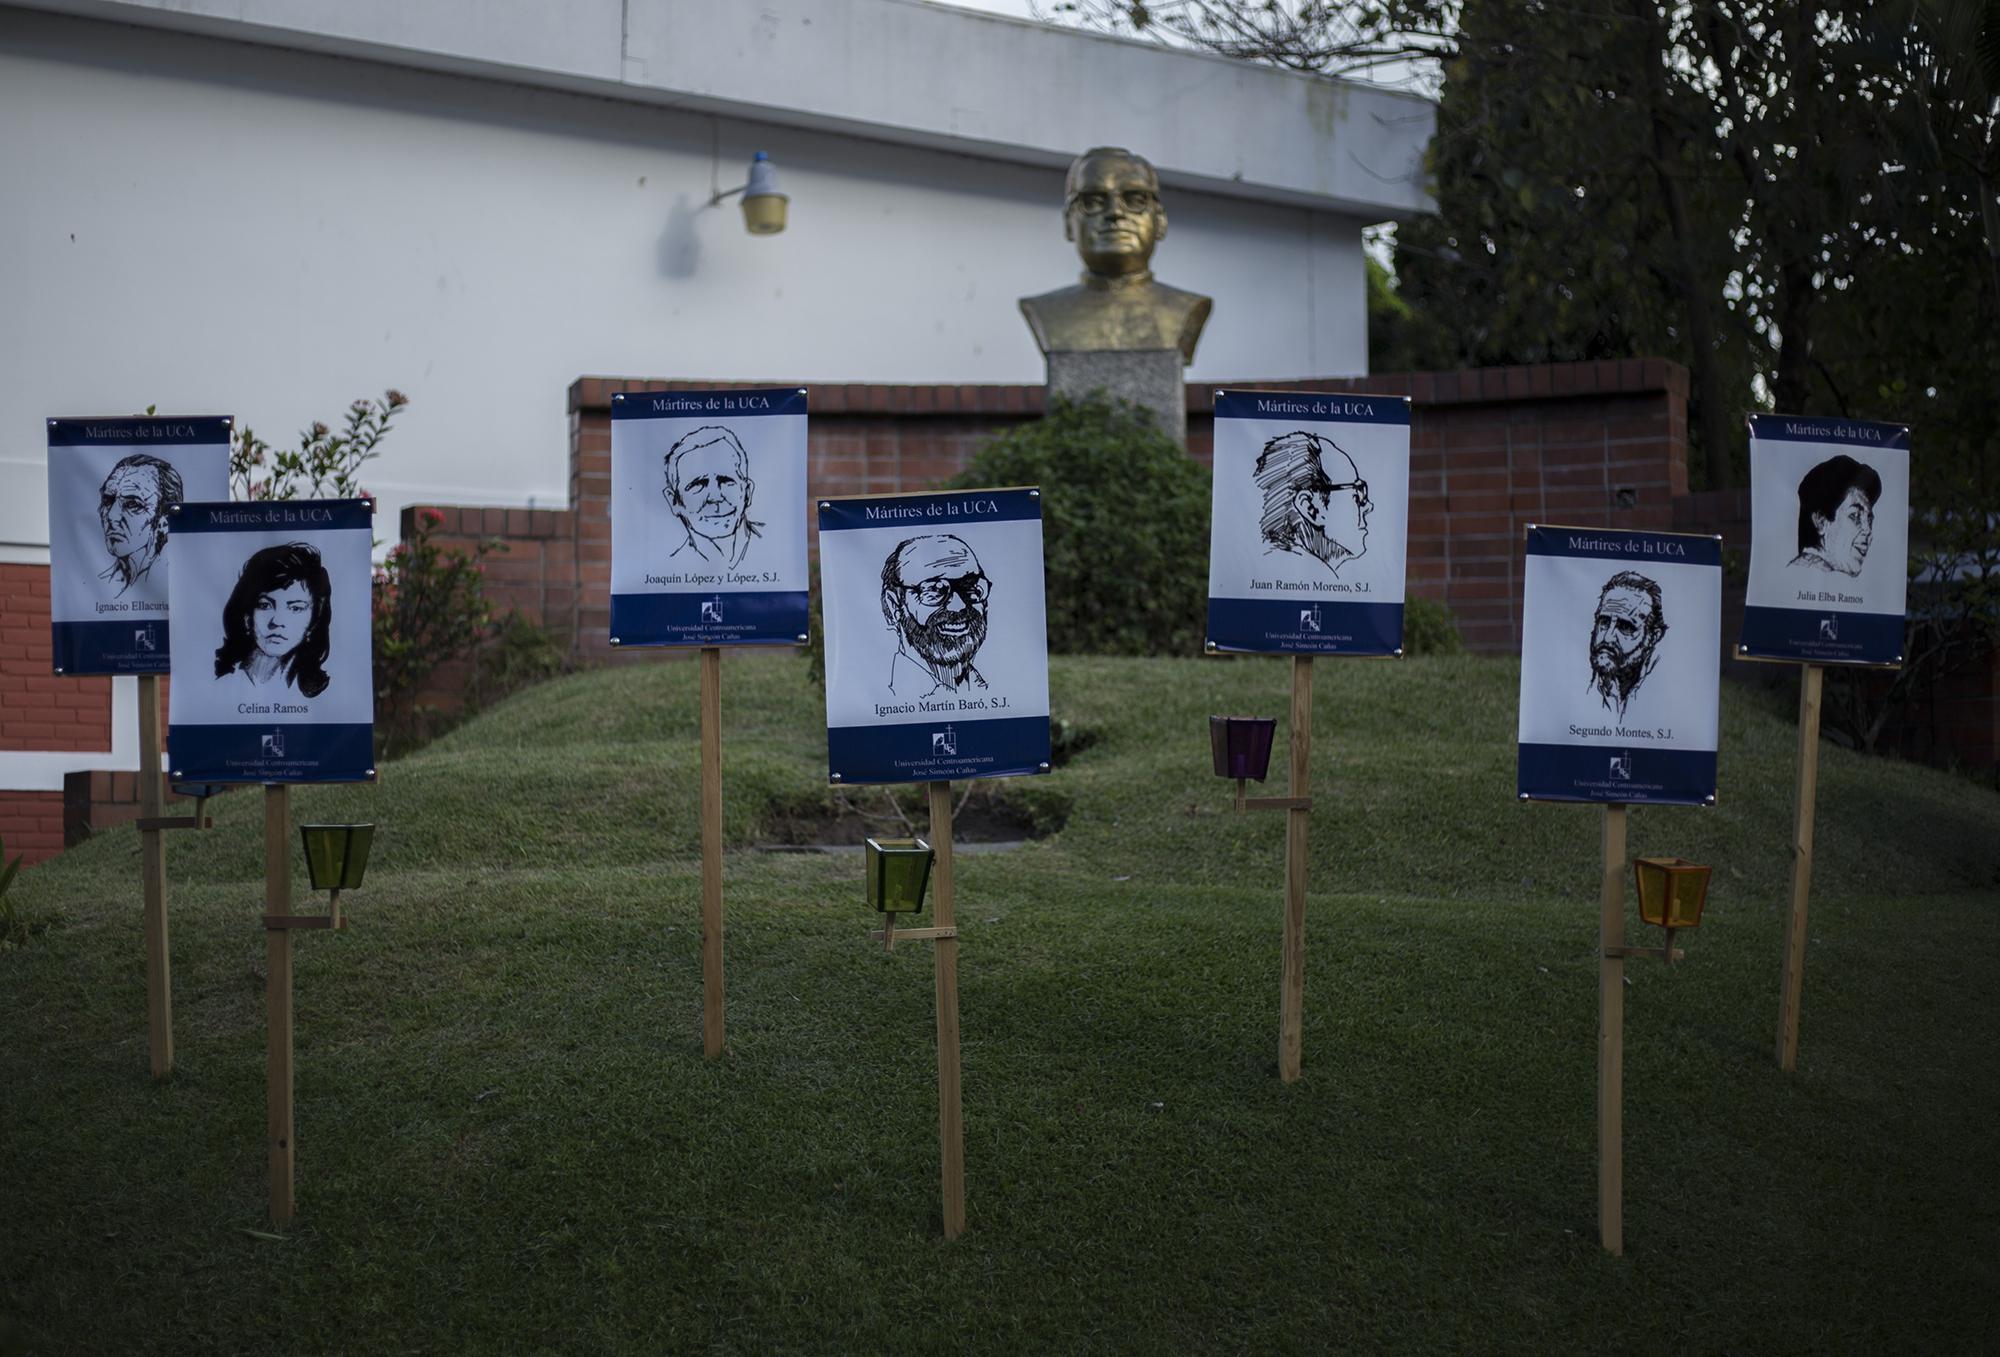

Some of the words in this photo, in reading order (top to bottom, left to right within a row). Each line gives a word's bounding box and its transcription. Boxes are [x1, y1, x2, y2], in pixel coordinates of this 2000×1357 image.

[652, 398, 703, 411] Mártires
[706, 398, 720, 410] de
[724, 397, 735, 409] la
[739, 397, 770, 409] UCA
[1257, 399, 1309, 413] Mártires
[1312, 402, 1327, 414] de
[1331, 402, 1341, 414] la
[1345, 403, 1374, 416] UCA
[86, 426, 133, 439] Mártires
[136, 426, 149, 437] de
[153, 425, 163, 437] la
[166, 424, 195, 437] UCA
[1834, 424, 1846, 437] de
[1849, 426, 1856, 438] la
[1859, 428, 1881, 441] UCA
[209, 510, 261, 523] Mártires
[265, 510, 280, 522] de
[284, 508, 295, 522] la
[300, 508, 333, 521] UCA
[865, 505, 923, 520] Mártires
[926, 503, 942, 517] de
[947, 502, 959, 515] la
[963, 500, 998, 514] UCA
[1569, 536, 1621, 552] Mártires
[1624, 539, 1640, 553] de
[1643, 540, 1653, 553] la
[1657, 541, 1685, 556] UCA
[645, 573, 682, 585] Joaquín
[685, 573, 714, 585] López
[717, 577, 724, 585] y
[727, 573, 760, 585] López,
[763, 573, 780, 583] S.J.
[1250, 579, 1273, 590] Juan
[1275, 580, 1310, 591] Ramón
[1312, 581, 1352, 593] Moreno,
[1355, 583, 1372, 593] S.J.
[1797, 591, 1816, 601] Julia
[1819, 592, 1835, 602] Elba
[1838, 594, 1863, 604] Ramos
[95, 602, 128, 613] Ignacio
[237, 703, 270, 714] Celina
[273, 703, 309, 714] Ramos
[875, 702, 916, 717] Ignacio
[919, 700, 955, 712] Martín
[992, 697, 1010, 708] S.J.
[1569, 725, 1612, 738] Segundo
[1615, 727, 1654, 739] Montes,
[1657, 729, 1674, 740] S.J.
[894, 758, 935, 768] Universidad
[936, 755, 994, 766] Centroamericana
